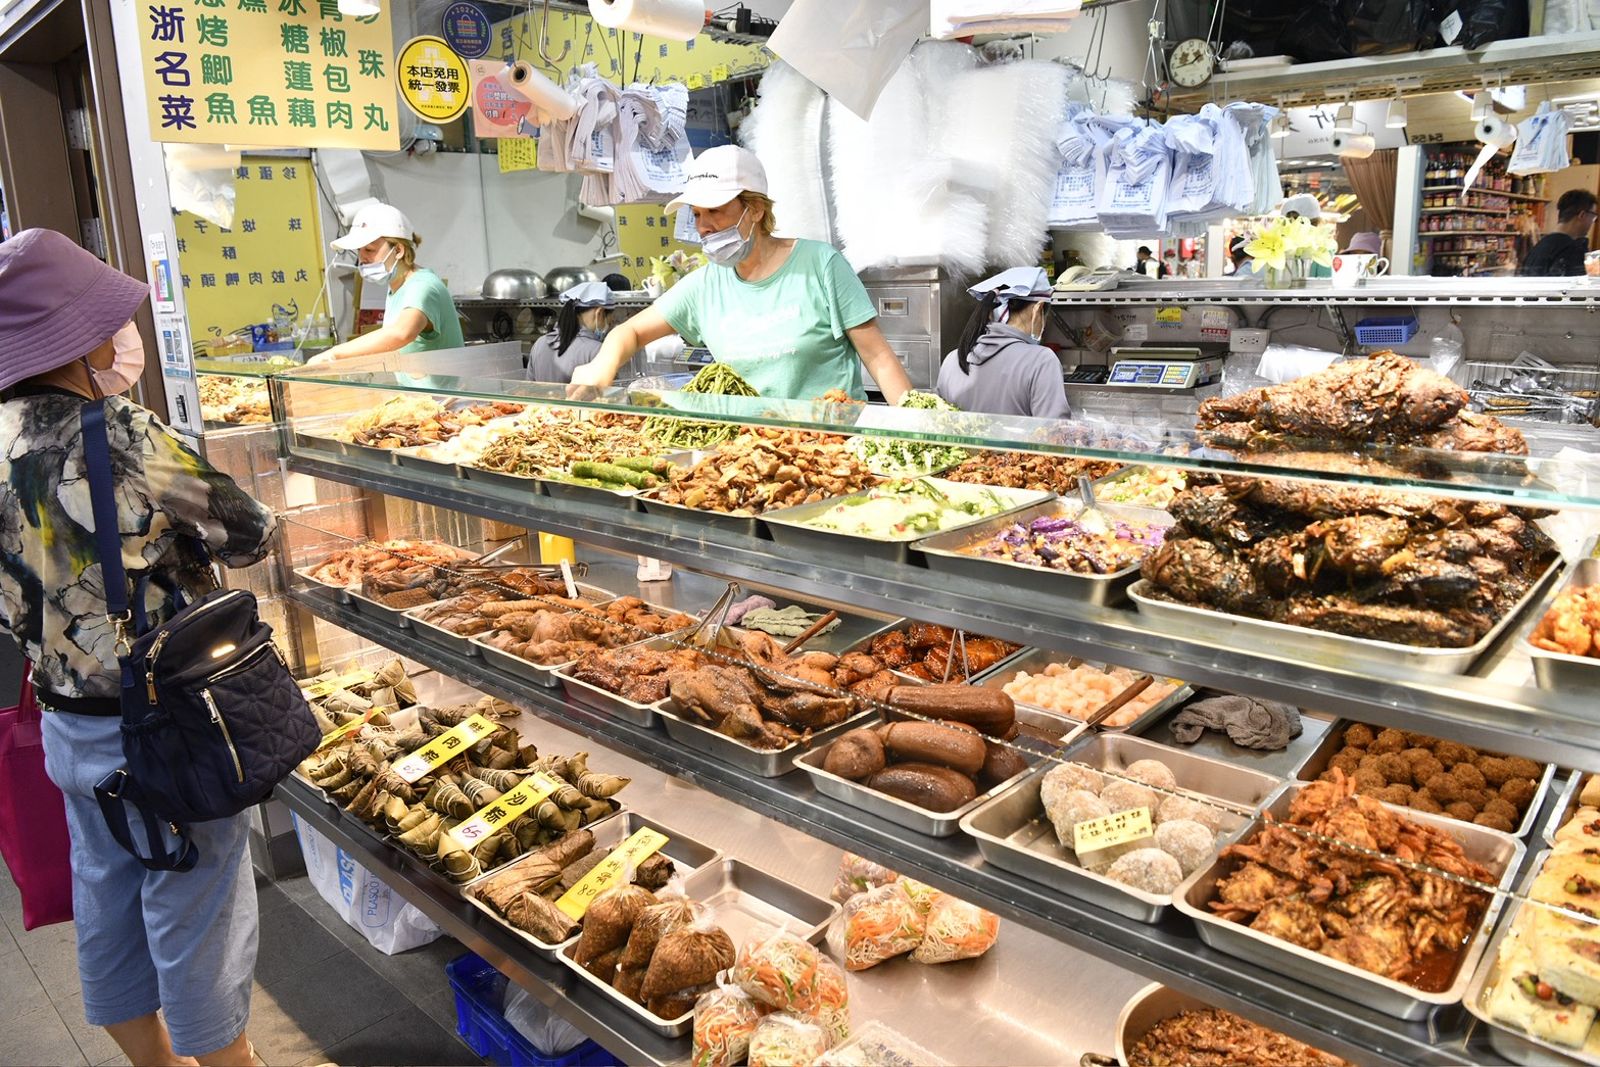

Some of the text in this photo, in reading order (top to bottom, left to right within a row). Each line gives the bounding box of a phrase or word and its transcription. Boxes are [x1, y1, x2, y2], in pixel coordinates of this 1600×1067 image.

[455, 6, 474, 16] 2024
[149, 5, 197, 130] 浙名菜
[195, 0, 238, 124] 烤鯽魚
[355, 15, 389, 132] 珠丸
[406, 65, 459, 80] 本店免用
[407, 78, 461, 93] 統一發票
[462, 825, 482, 838] 65
[367, 878, 380, 916] PLASCO
